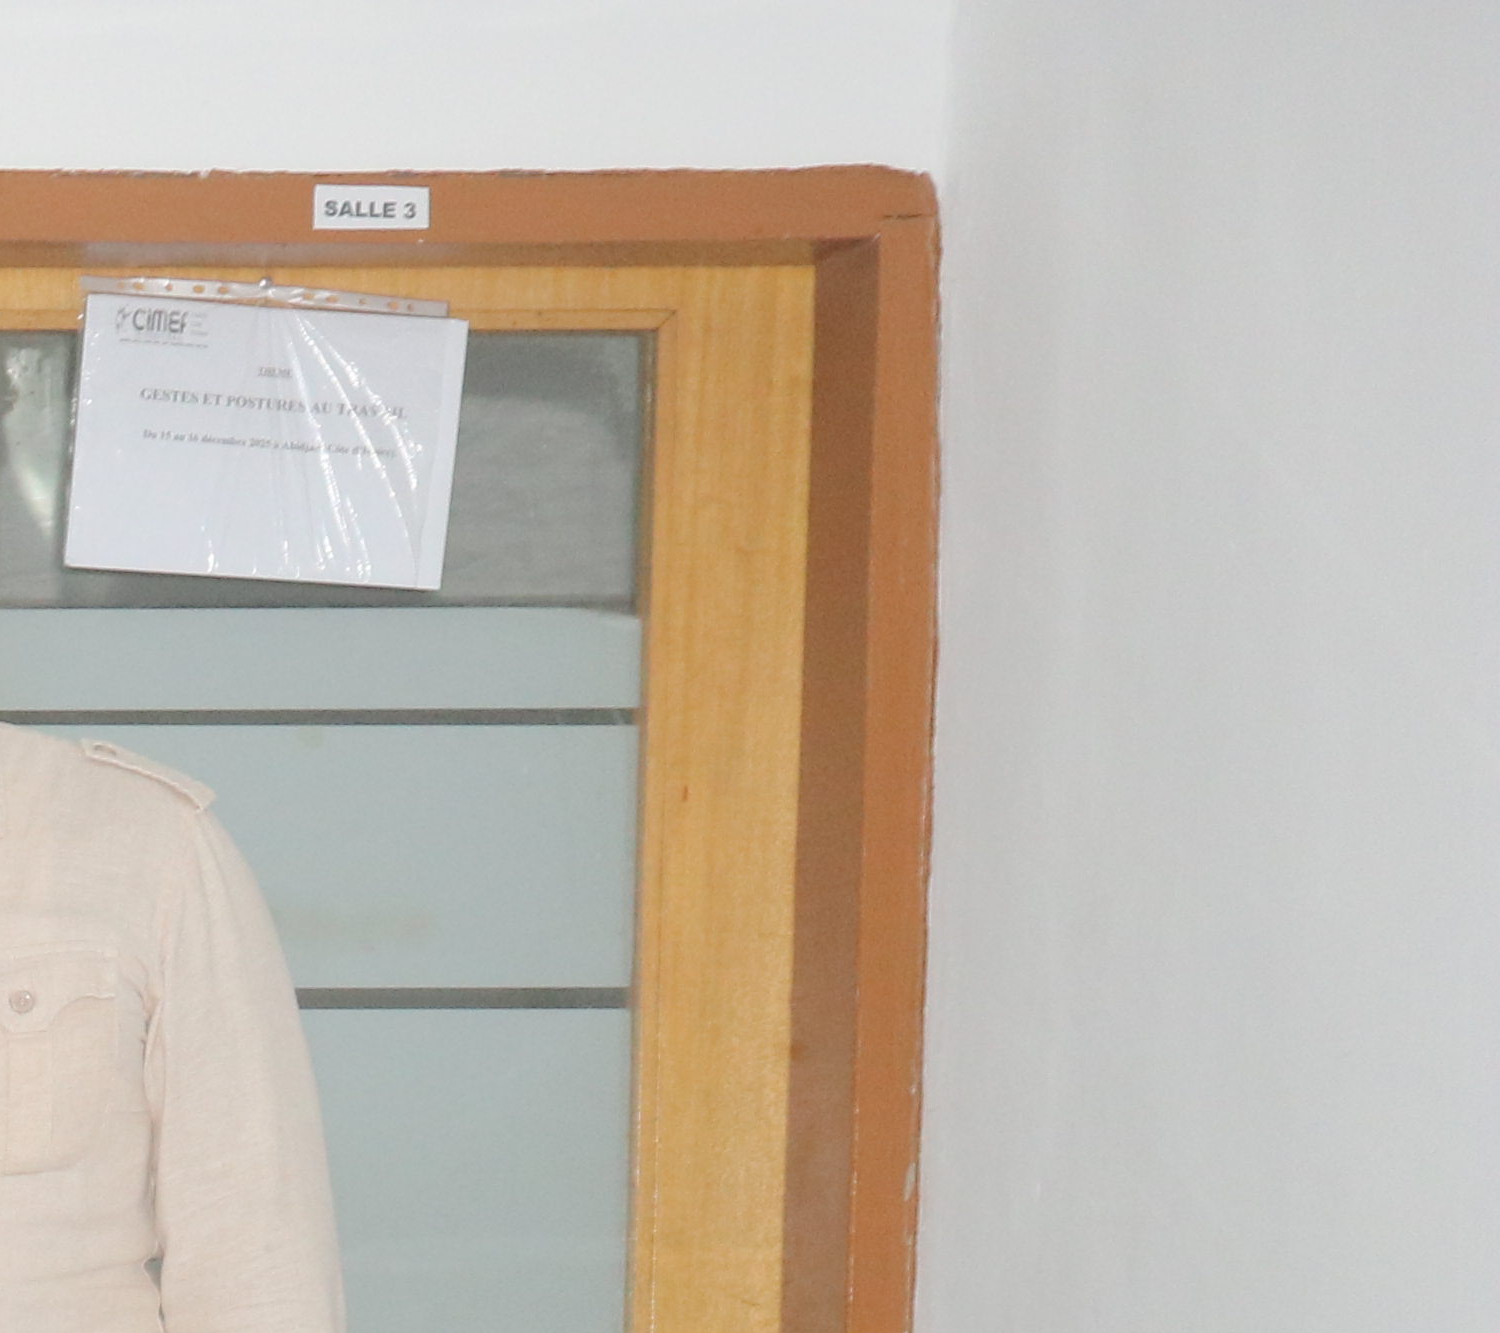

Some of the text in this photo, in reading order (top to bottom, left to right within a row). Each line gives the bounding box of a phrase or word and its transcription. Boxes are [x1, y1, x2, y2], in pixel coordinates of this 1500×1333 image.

[324, 200, 417, 219] SALLE 3
[202, 393, 223, 406] ET
[226, 396, 307, 414] POSTURES
